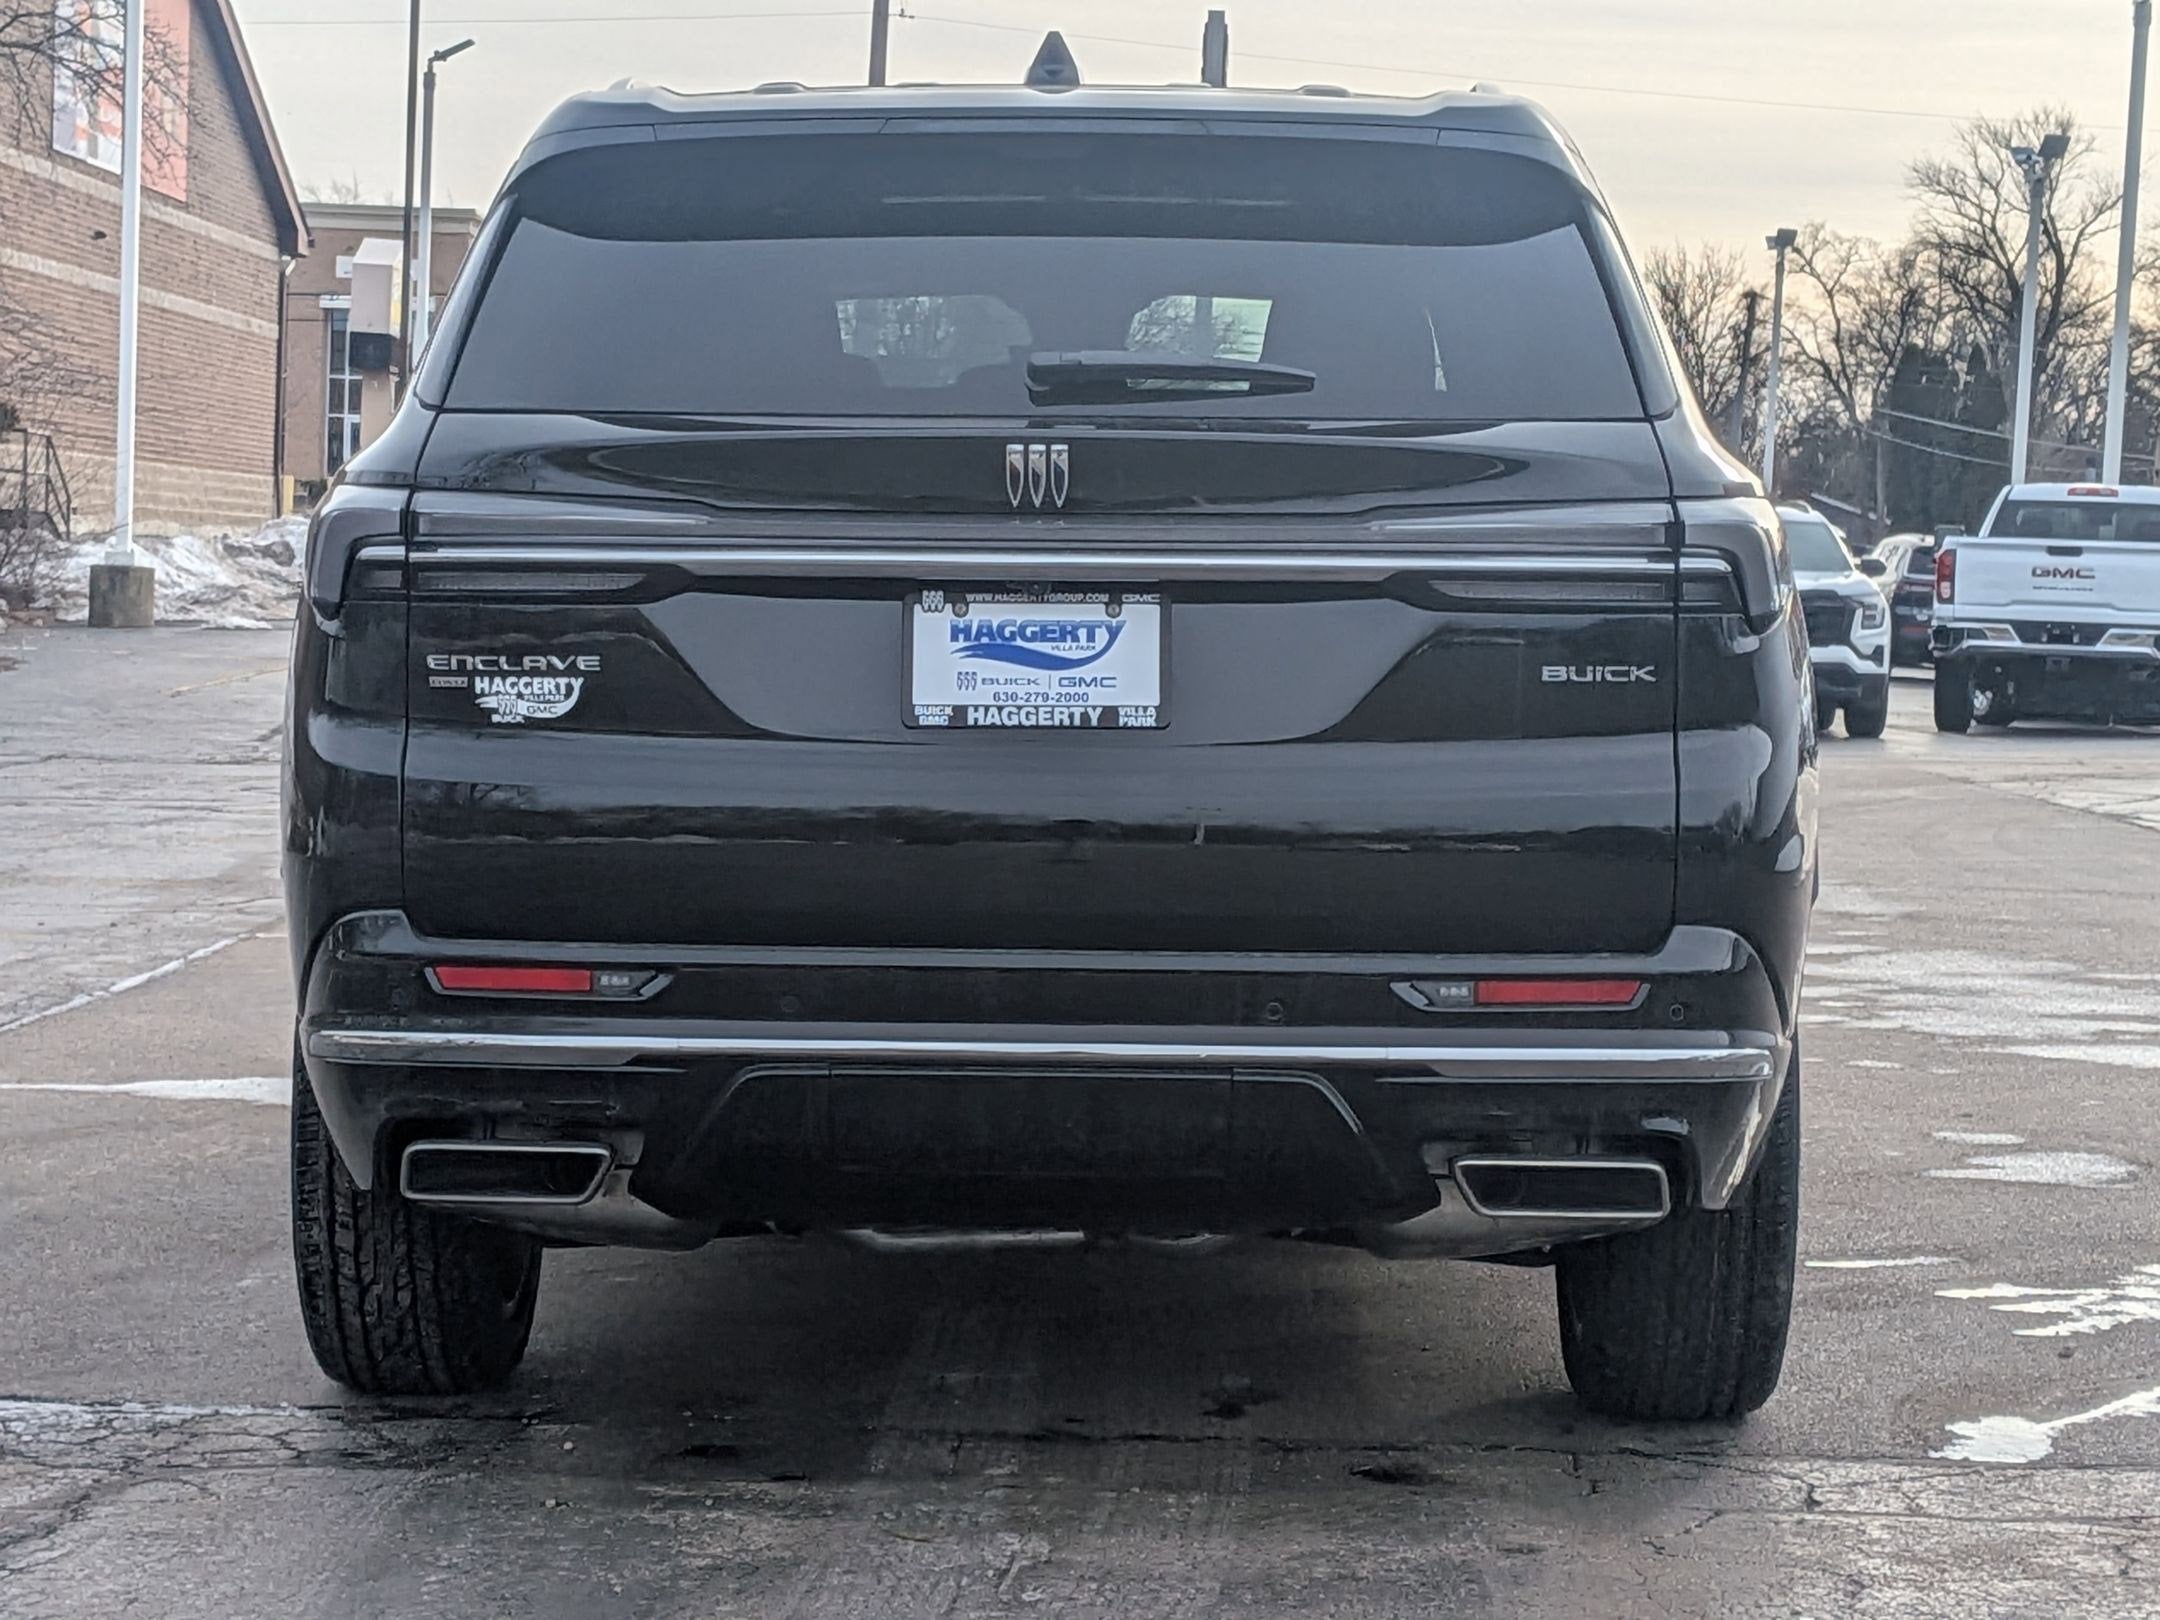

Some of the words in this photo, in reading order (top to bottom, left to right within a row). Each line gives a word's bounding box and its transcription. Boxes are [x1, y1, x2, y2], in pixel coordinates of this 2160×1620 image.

[2031, 567, 2096, 579] GMC
[1122, 594, 1160, 602] GMC
[949, 619, 1127, 643] HAGGERTY
[426, 654, 601, 671] ENCLAVE
[1541, 665, 1657, 682] BUICK
[474, 676, 584, 694] HAGGERTY
[981, 677, 1040, 686] BUICK
[1058, 677, 1117, 688] GMC
[992, 692, 1089, 703] 630-279-2000
[526, 705, 558, 714] GMC
[966, 706, 1103, 727] HAGGERTY
